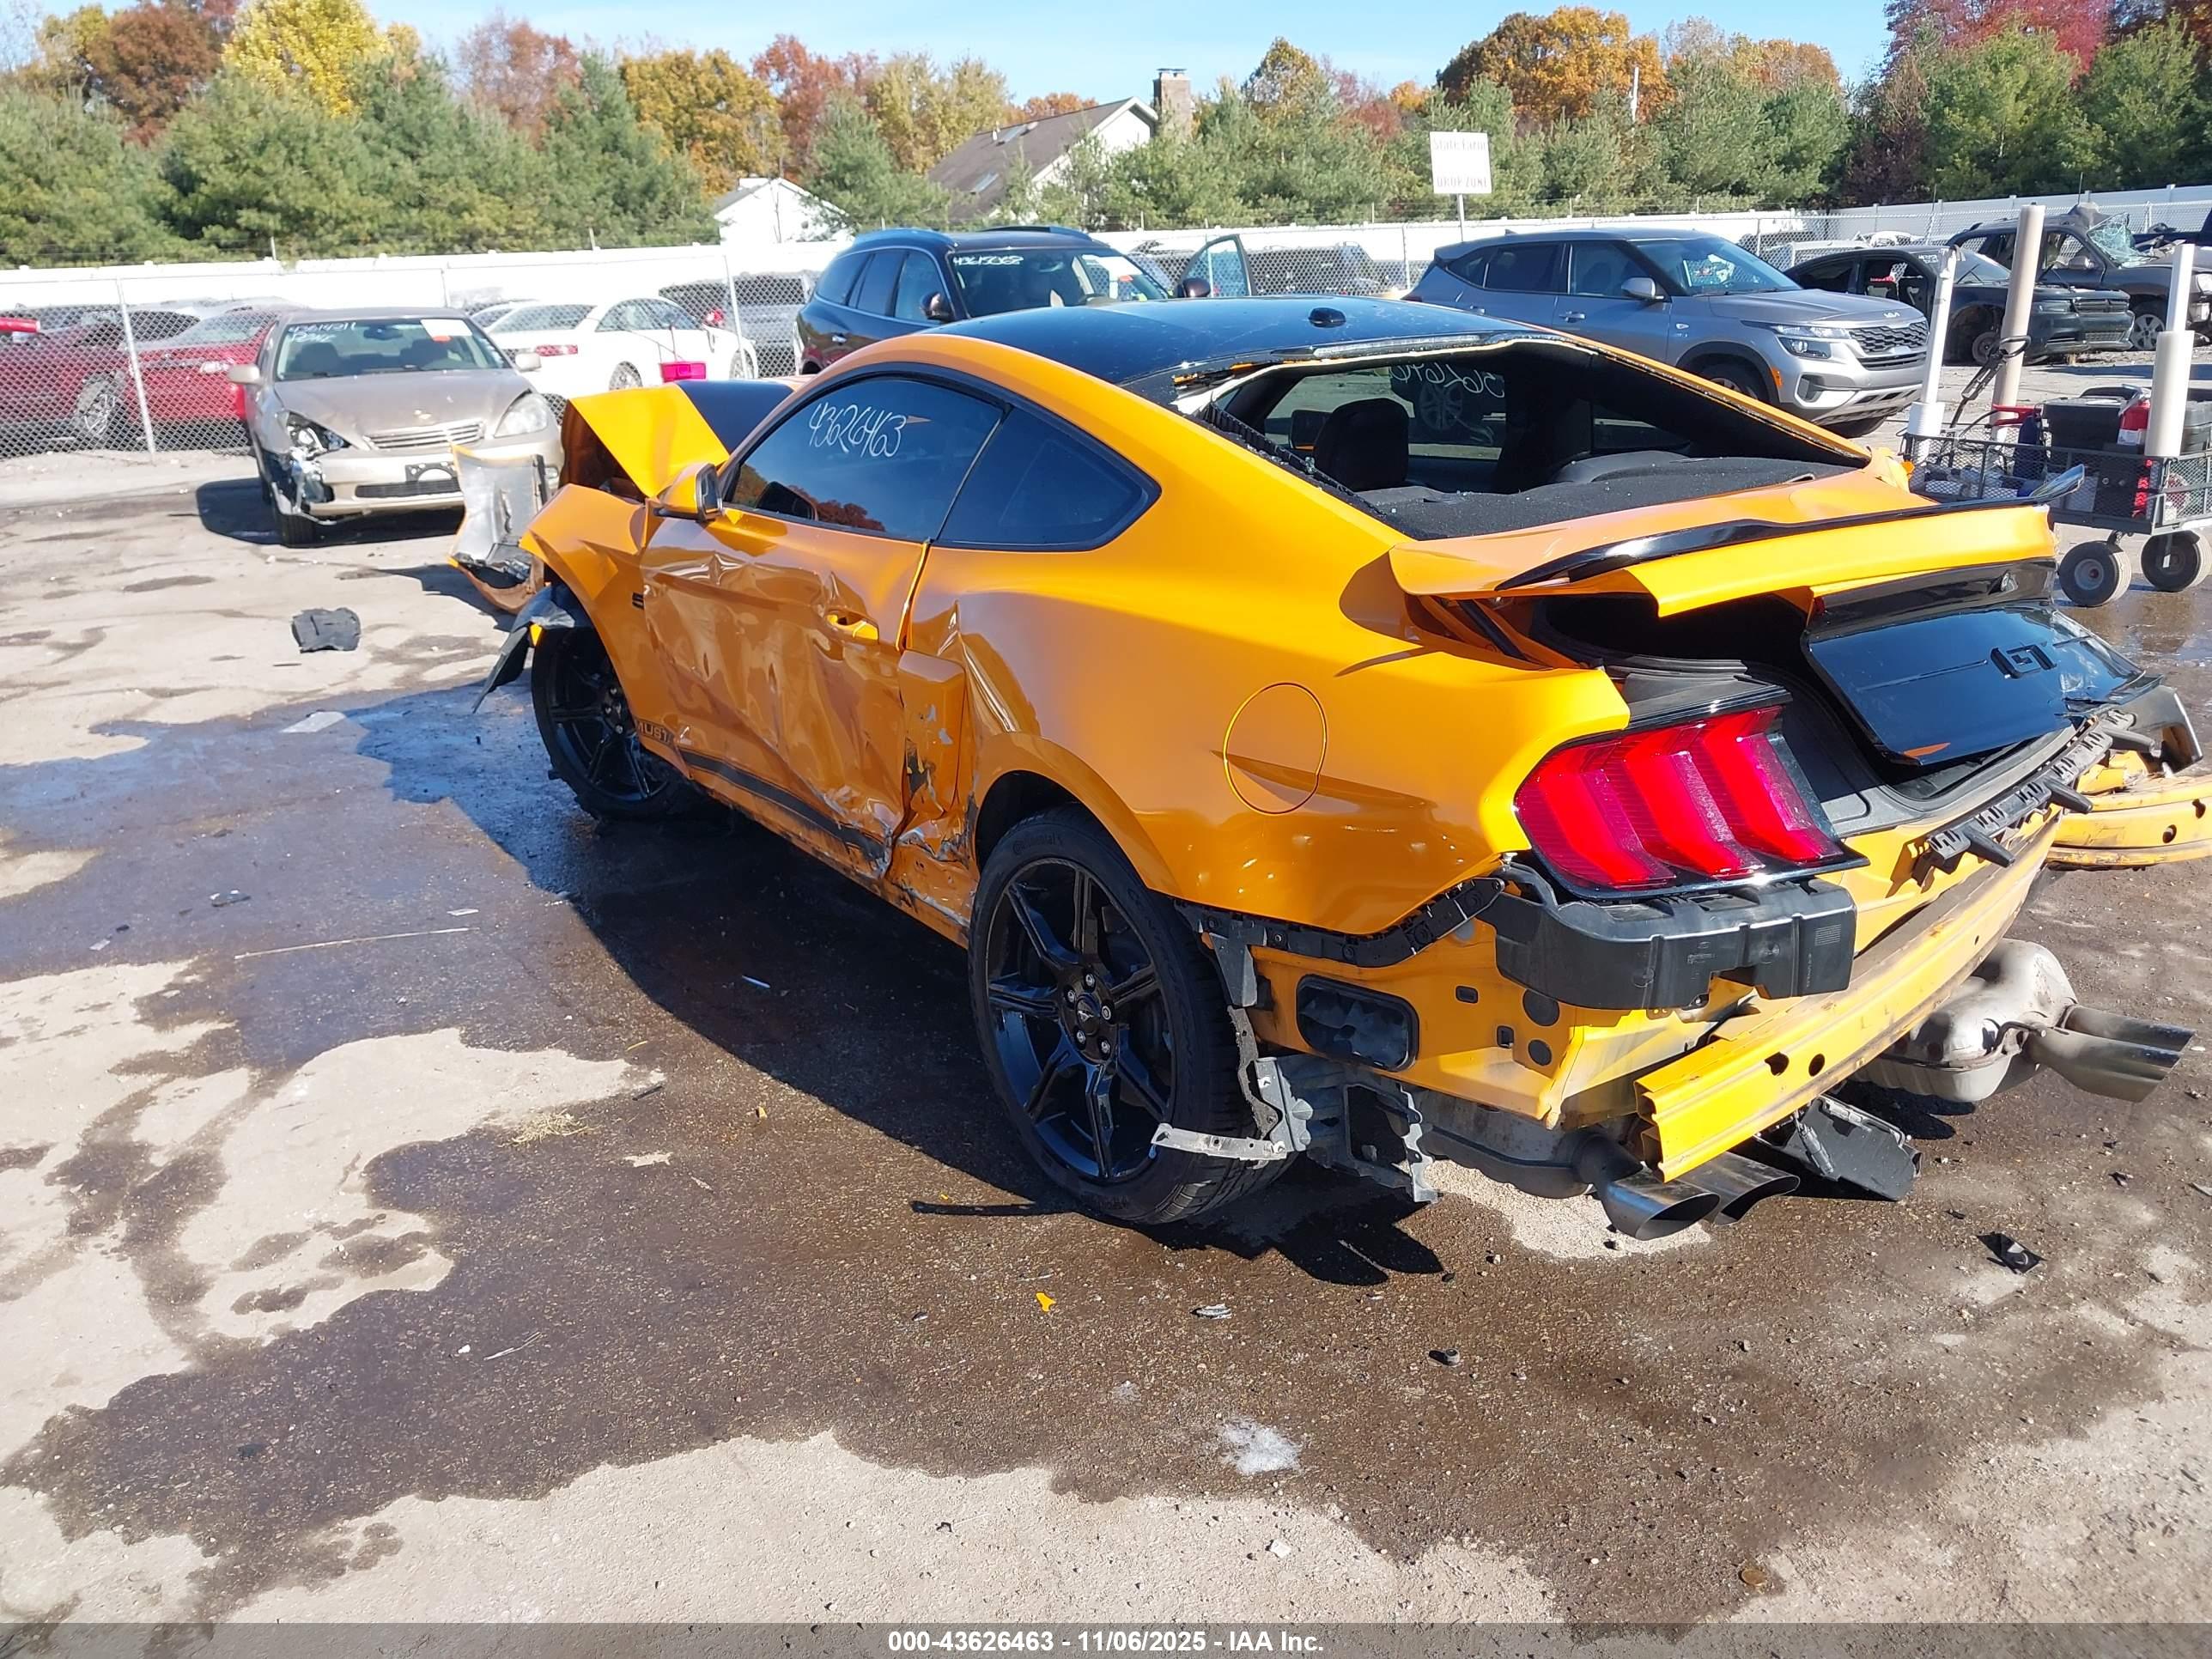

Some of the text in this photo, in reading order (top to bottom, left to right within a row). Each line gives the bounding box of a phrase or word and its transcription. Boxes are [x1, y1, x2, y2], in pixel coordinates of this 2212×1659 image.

[1433, 137, 1460, 151] State
[809, 402, 907, 458] 43626463
[1990, 643, 2057, 679] GT
